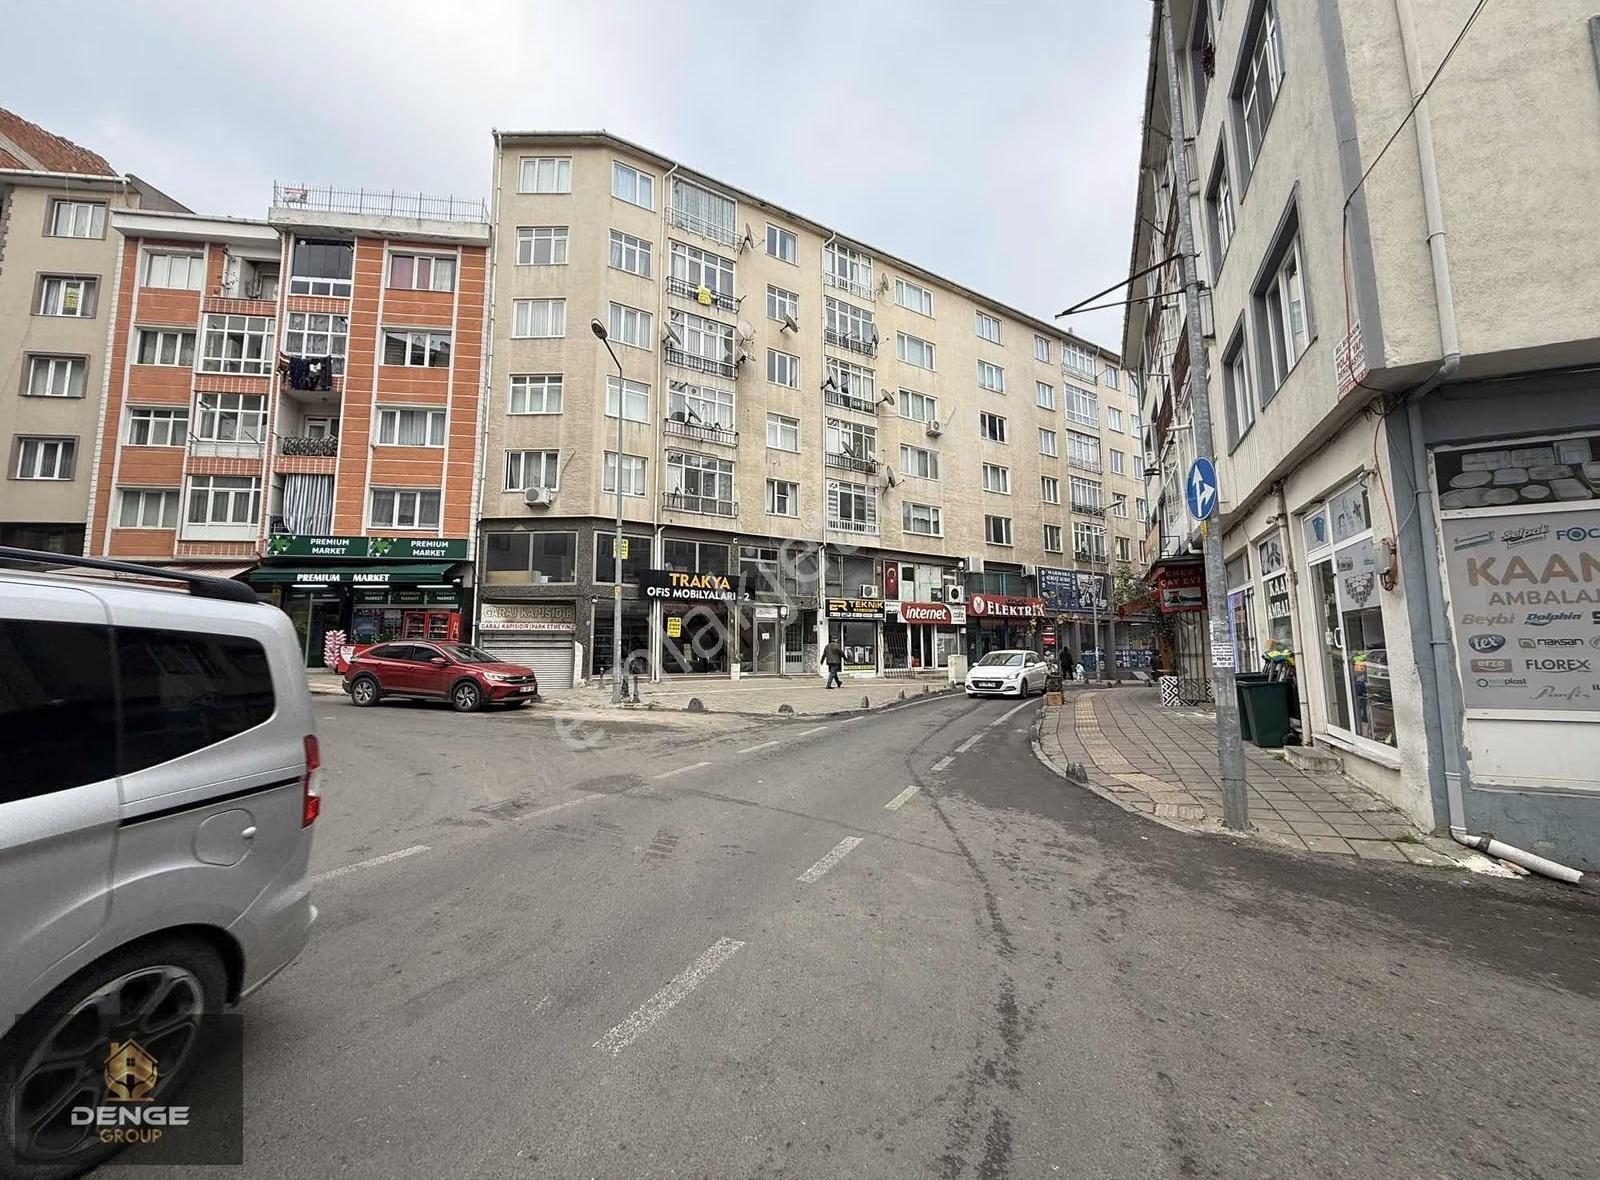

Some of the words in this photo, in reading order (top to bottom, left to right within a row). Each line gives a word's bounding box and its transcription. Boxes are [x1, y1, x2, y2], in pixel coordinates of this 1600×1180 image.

[310, 538, 349, 546] PREMIUM
[411, 540, 448, 548] PREMIUM
[412, 549, 445, 557] MARKET
[296, 573, 340, 581] PREMIUM
[669, 573, 731, 589] TRAKYA
[743, 593, 750, 601] 2
[484, 606, 517, 618] GARAJ
[519, 607, 573, 618] KAPISIDIR
[905, 605, 947, 620] internet
[1461, 612, 1516, 626] Beybi
[1525, 611, 1583, 621] Dolphin
[1537, 638, 1584, 646] naksan
[1526, 659, 1591, 670] FLOREX
